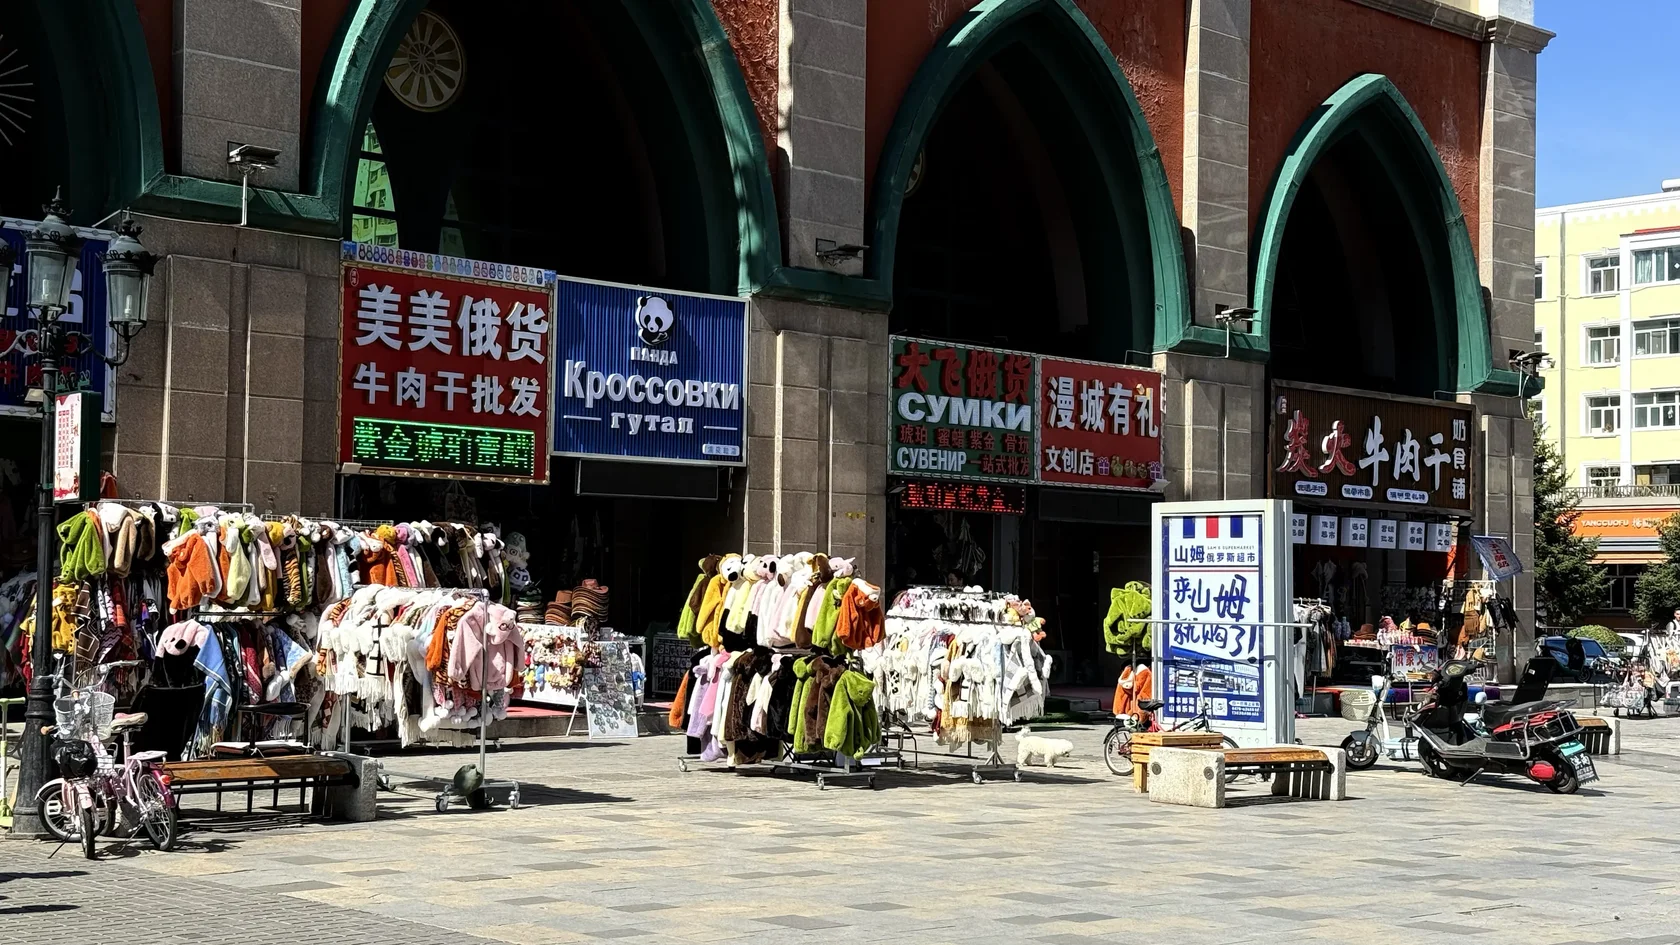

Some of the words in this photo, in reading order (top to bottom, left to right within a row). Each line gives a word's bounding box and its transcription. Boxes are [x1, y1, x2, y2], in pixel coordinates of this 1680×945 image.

[356, 283, 549, 365] 美美俄货
[630, 346, 678, 366] ПАНДА
[895, 341, 1032, 403] 大飞俄货
[353, 362, 542, 417] 牛肉干批发
[564, 359, 739, 410] Кроссовки
[1047, 376, 1159, 438] 漫城有礼
[611, 412, 694, 435] гутал
[897, 391, 1032, 433] СУМКИ
[900, 424, 928, 445] 琥珀
[936, 427, 965, 449] 蜜蜡
[969, 429, 996, 451] 紫金
[1045, 444, 1094, 477] 文创店
[1275, 409, 1451, 491] 炭火牛肉干
[1452, 418, 1466, 500] 奶食铺
[896, 446, 967, 472] СУВЕНИР
[970, 454, 1031, 476] 一站式批发
[1174, 545, 1205, 563] 山姆
[1206, 552, 1256, 563] 俄罗斯超市
